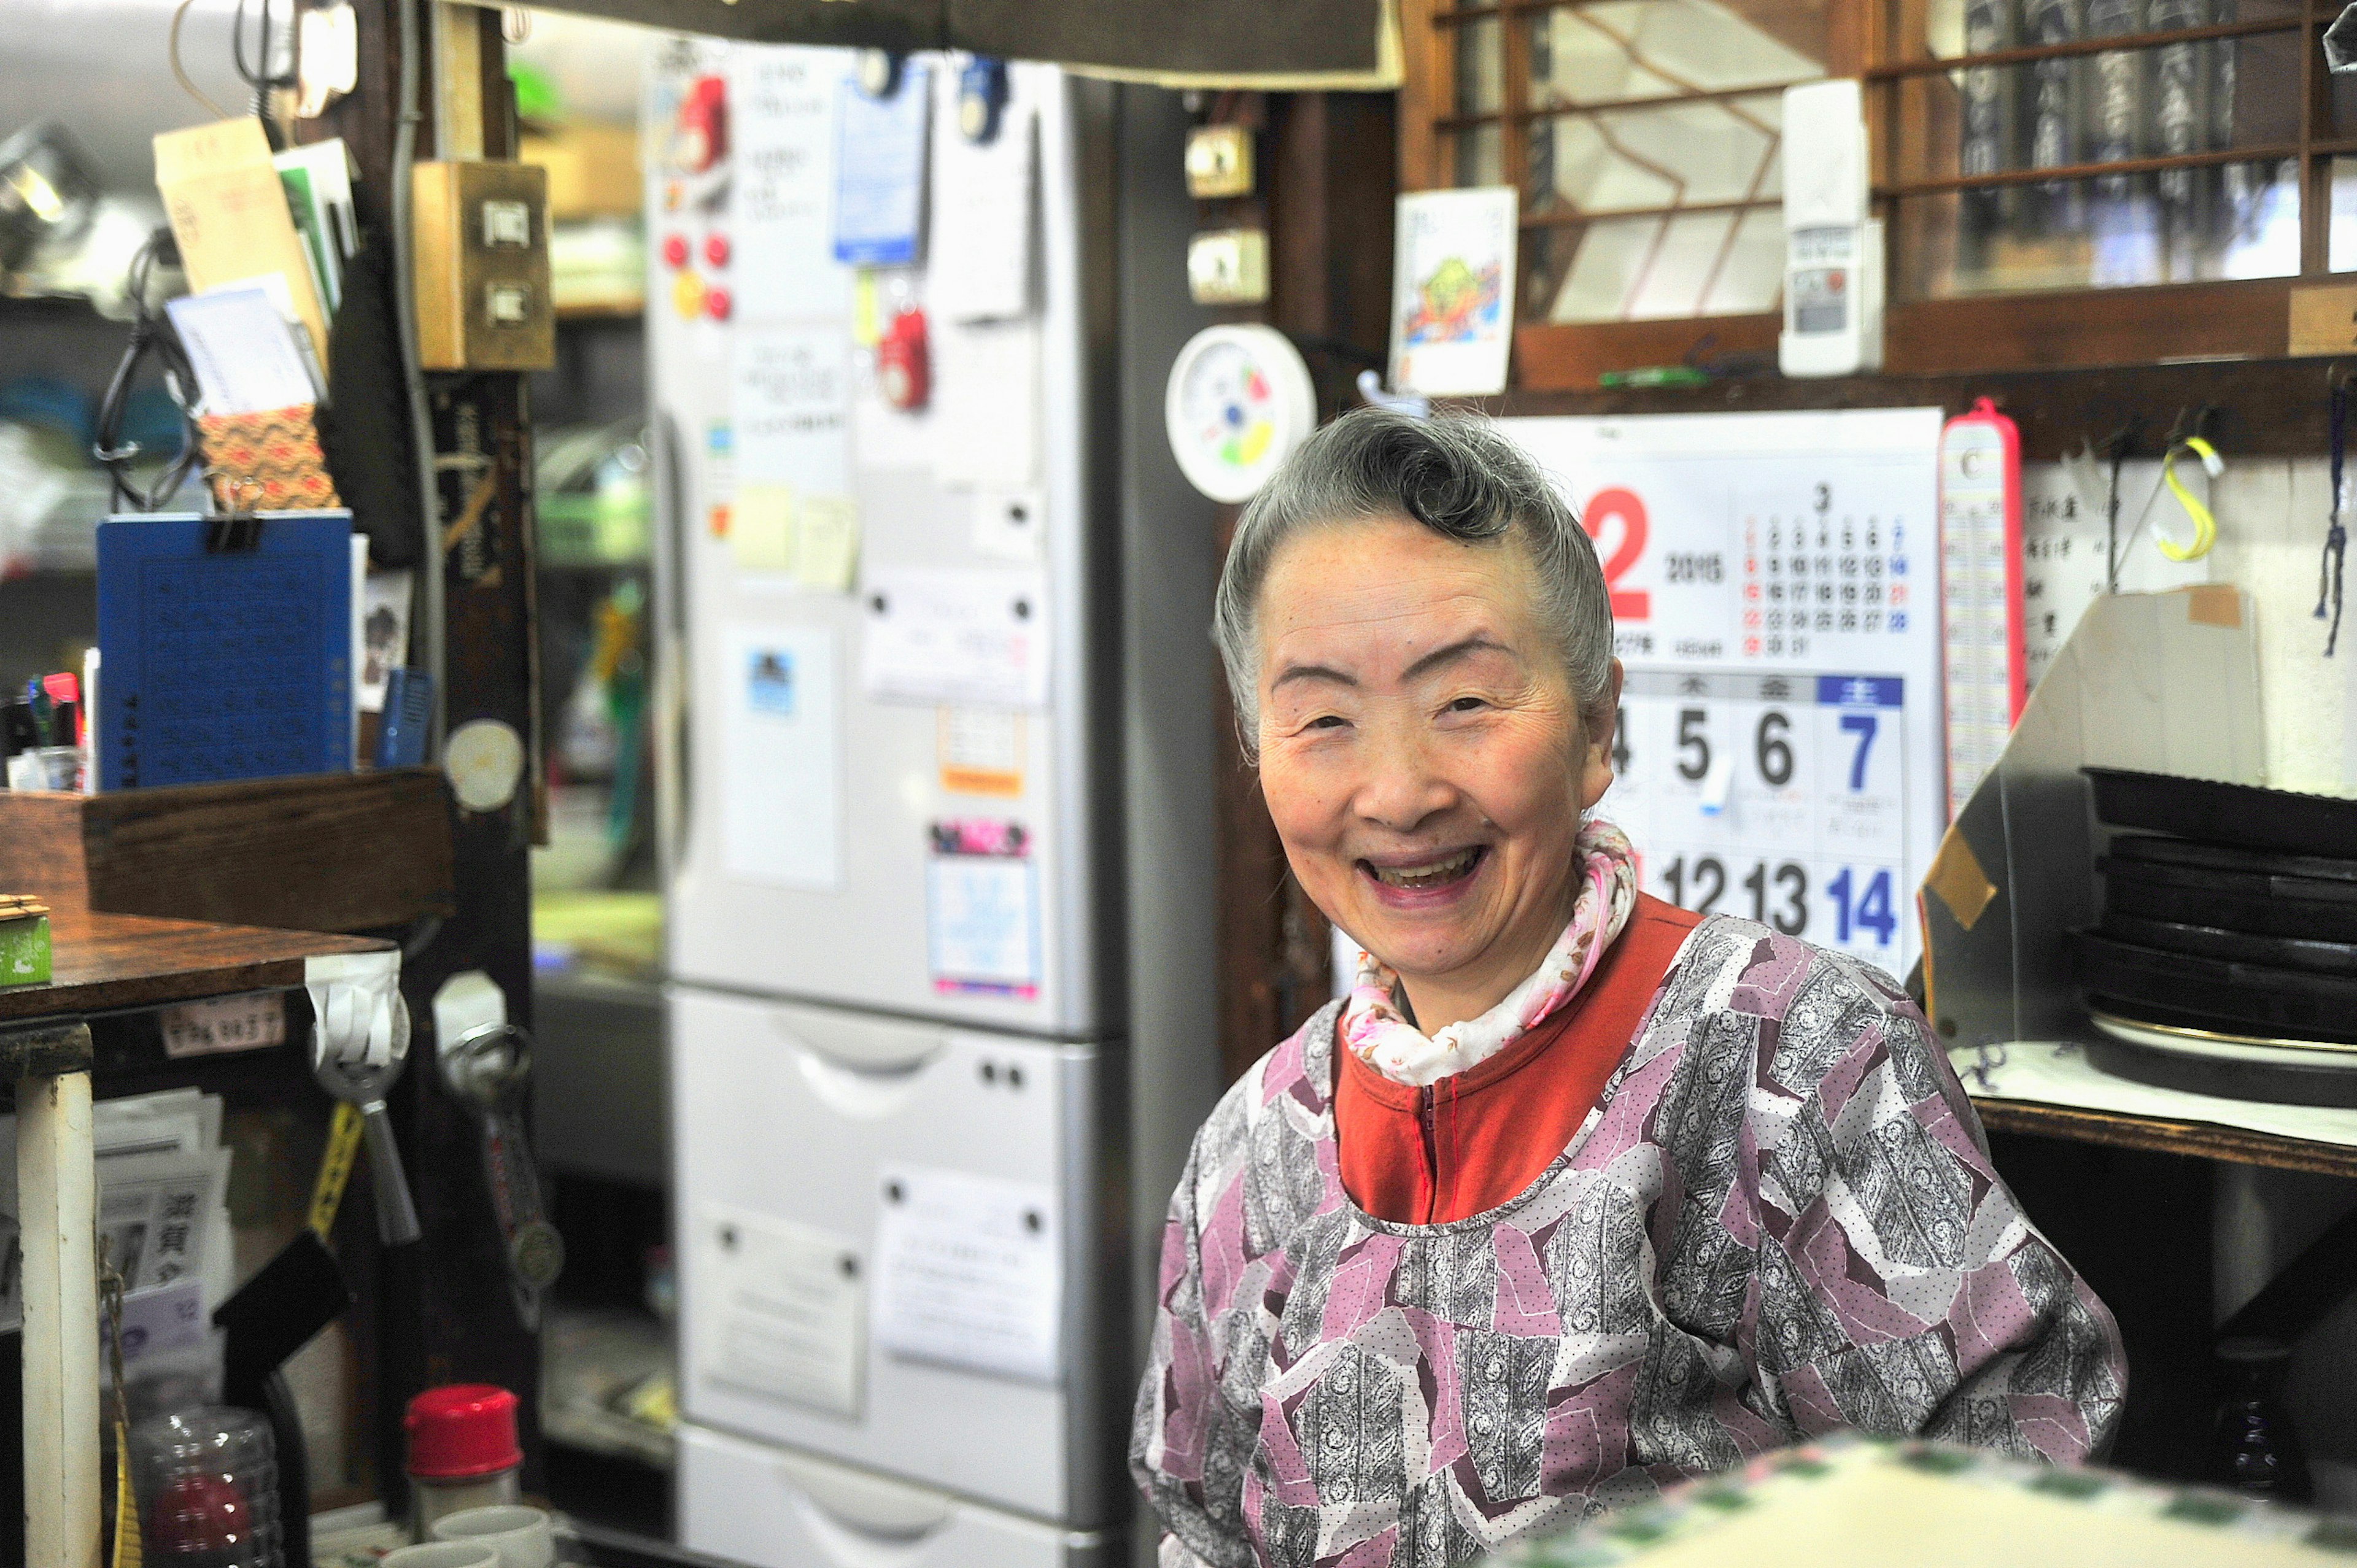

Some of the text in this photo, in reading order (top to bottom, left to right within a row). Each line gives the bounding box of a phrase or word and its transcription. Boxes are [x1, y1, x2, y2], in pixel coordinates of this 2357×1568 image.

[1815, 482, 1832, 514] 3
[1584, 484, 1650, 620] 2
[1769, 528, 1781, 550] 2
[1793, 528, 1806, 550] 3
[1817, 528, 1830, 549] 4
[1842, 528, 1854, 550] 5
[1867, 528, 1878, 550] 6
[1893, 528, 1905, 550] 7
[1666, 552, 1727, 585] 2015
[1746, 555, 1758, 574] 8
[1769, 559, 1782, 576] 9
[1790, 557, 1808, 577] 10
[1814, 556, 1833, 576] 11
[1839, 557, 1859, 578] 12
[1864, 556, 1884, 579] 13
[1744, 580, 1908, 606] 15 16 17 18 19 20 21
[1815, 610, 1833, 632] 25
[1840, 609, 1857, 631] 26
[1864, 610, 1883, 633] 27
[1745, 636, 1761, 657] 29
[1768, 634, 1784, 656] 30
[1792, 636, 1809, 656] 31
[1761, 675, 1791, 701] 金
[1678, 709, 1711, 782] 5
[1756, 711, 1795, 788] 6
[1840, 714, 1878, 790] 7
[1663, 855, 1897, 947] 12 13 14
